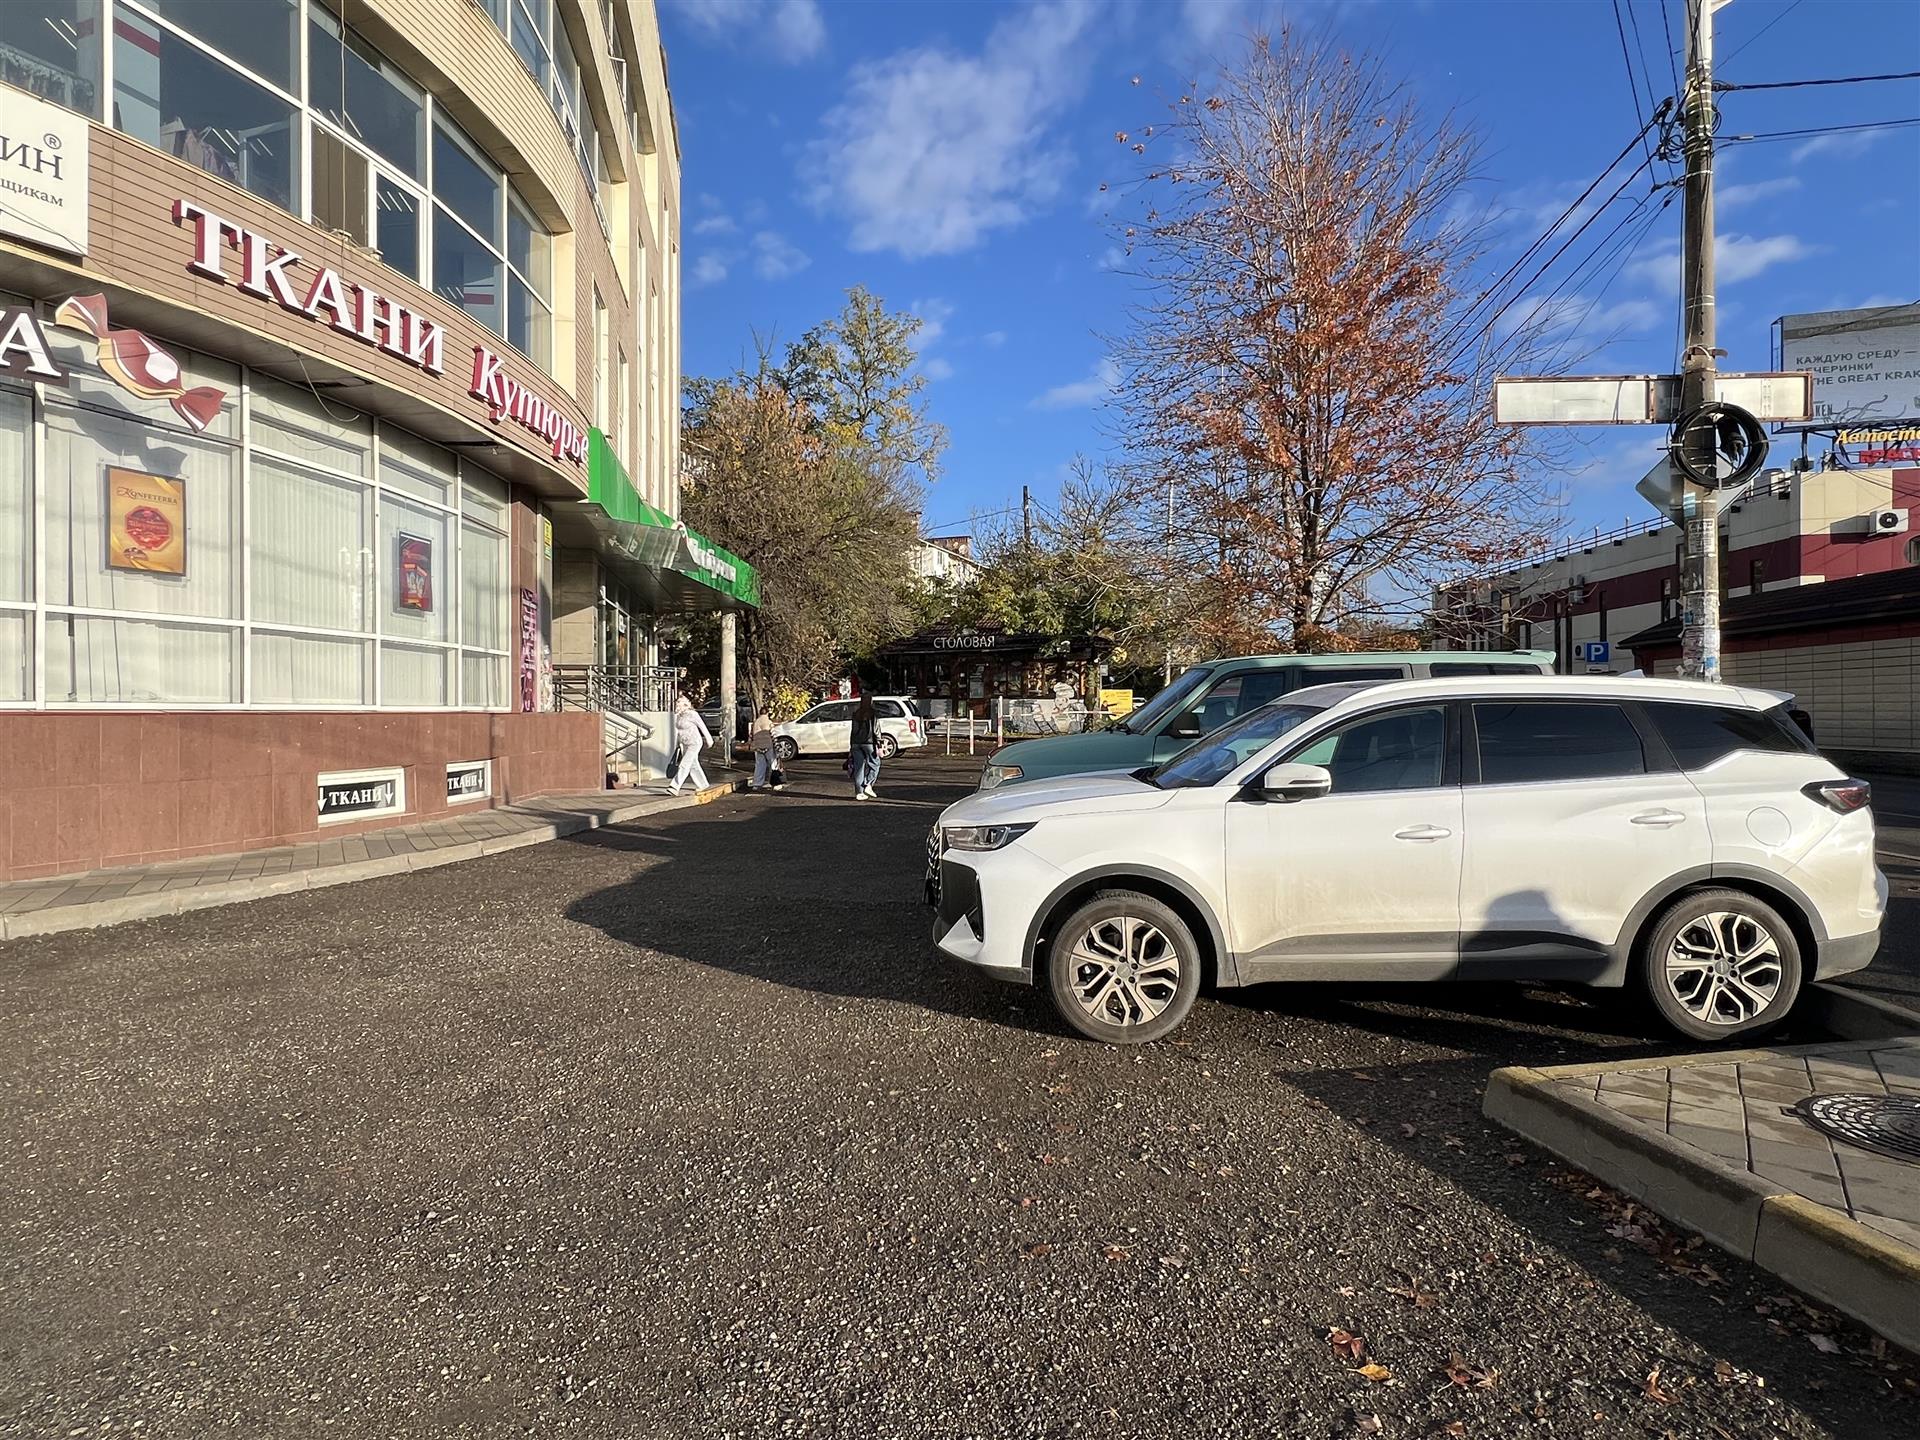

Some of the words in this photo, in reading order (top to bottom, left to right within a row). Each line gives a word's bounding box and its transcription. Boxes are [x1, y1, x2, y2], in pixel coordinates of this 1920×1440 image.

[172, 199, 447, 378] ТКАНИ
[469, 344, 589, 466] Кутюрье
[1796, 352, 1853, 365] КАЖДУЮ
[1857, 349, 1900, 360] СРЕДУ
[1813, 376, 1834, 386] HE
[1837, 372, 1882, 384] GREAT
[933, 635, 996, 649] СТОЛОВАЯ
[1591, 645, 1604, 662] P
[447, 774, 479, 790] ТКАНИ
[329, 787, 384, 806] ТКАНИ
